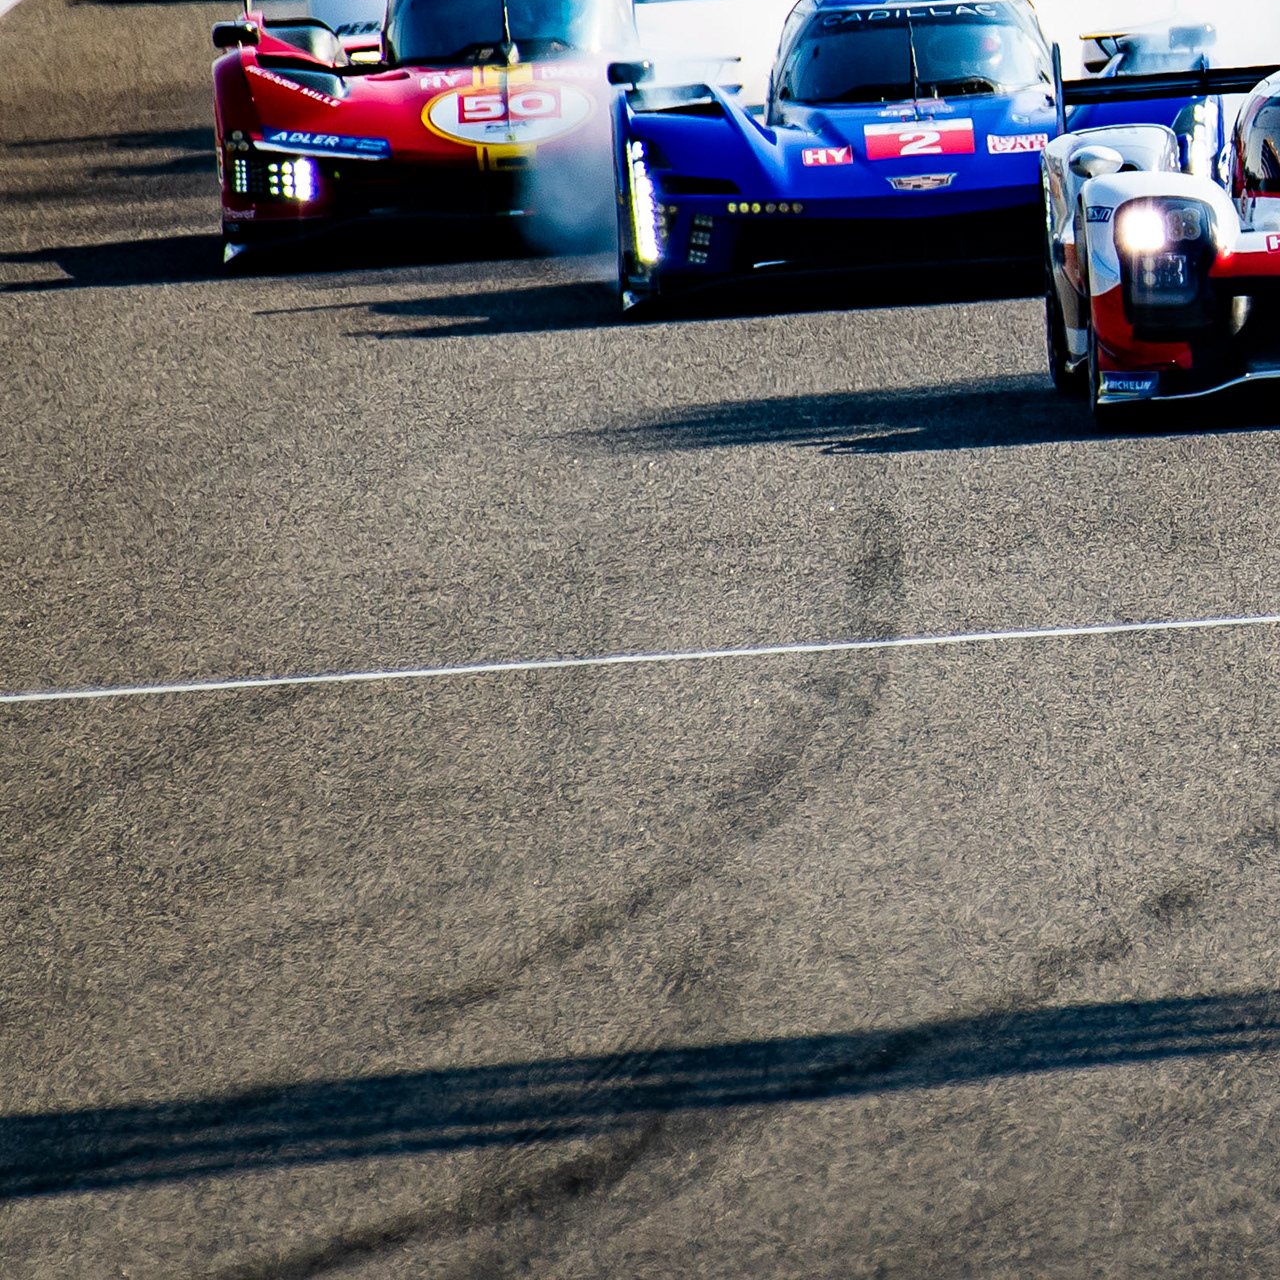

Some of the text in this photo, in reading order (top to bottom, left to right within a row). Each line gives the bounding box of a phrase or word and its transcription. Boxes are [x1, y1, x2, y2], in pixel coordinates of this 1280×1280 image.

[822, 4, 997, 27] CADILLAC
[301, 86, 342, 108] MILLE
[462, 91, 557, 120] 50
[269, 130, 341, 148] ADLER
[898, 131, 943, 156] 2
[992, 140, 1047, 152] CAR
[803, 148, 849, 165] HY
[1108, 380, 1153, 390] MICHELIN
